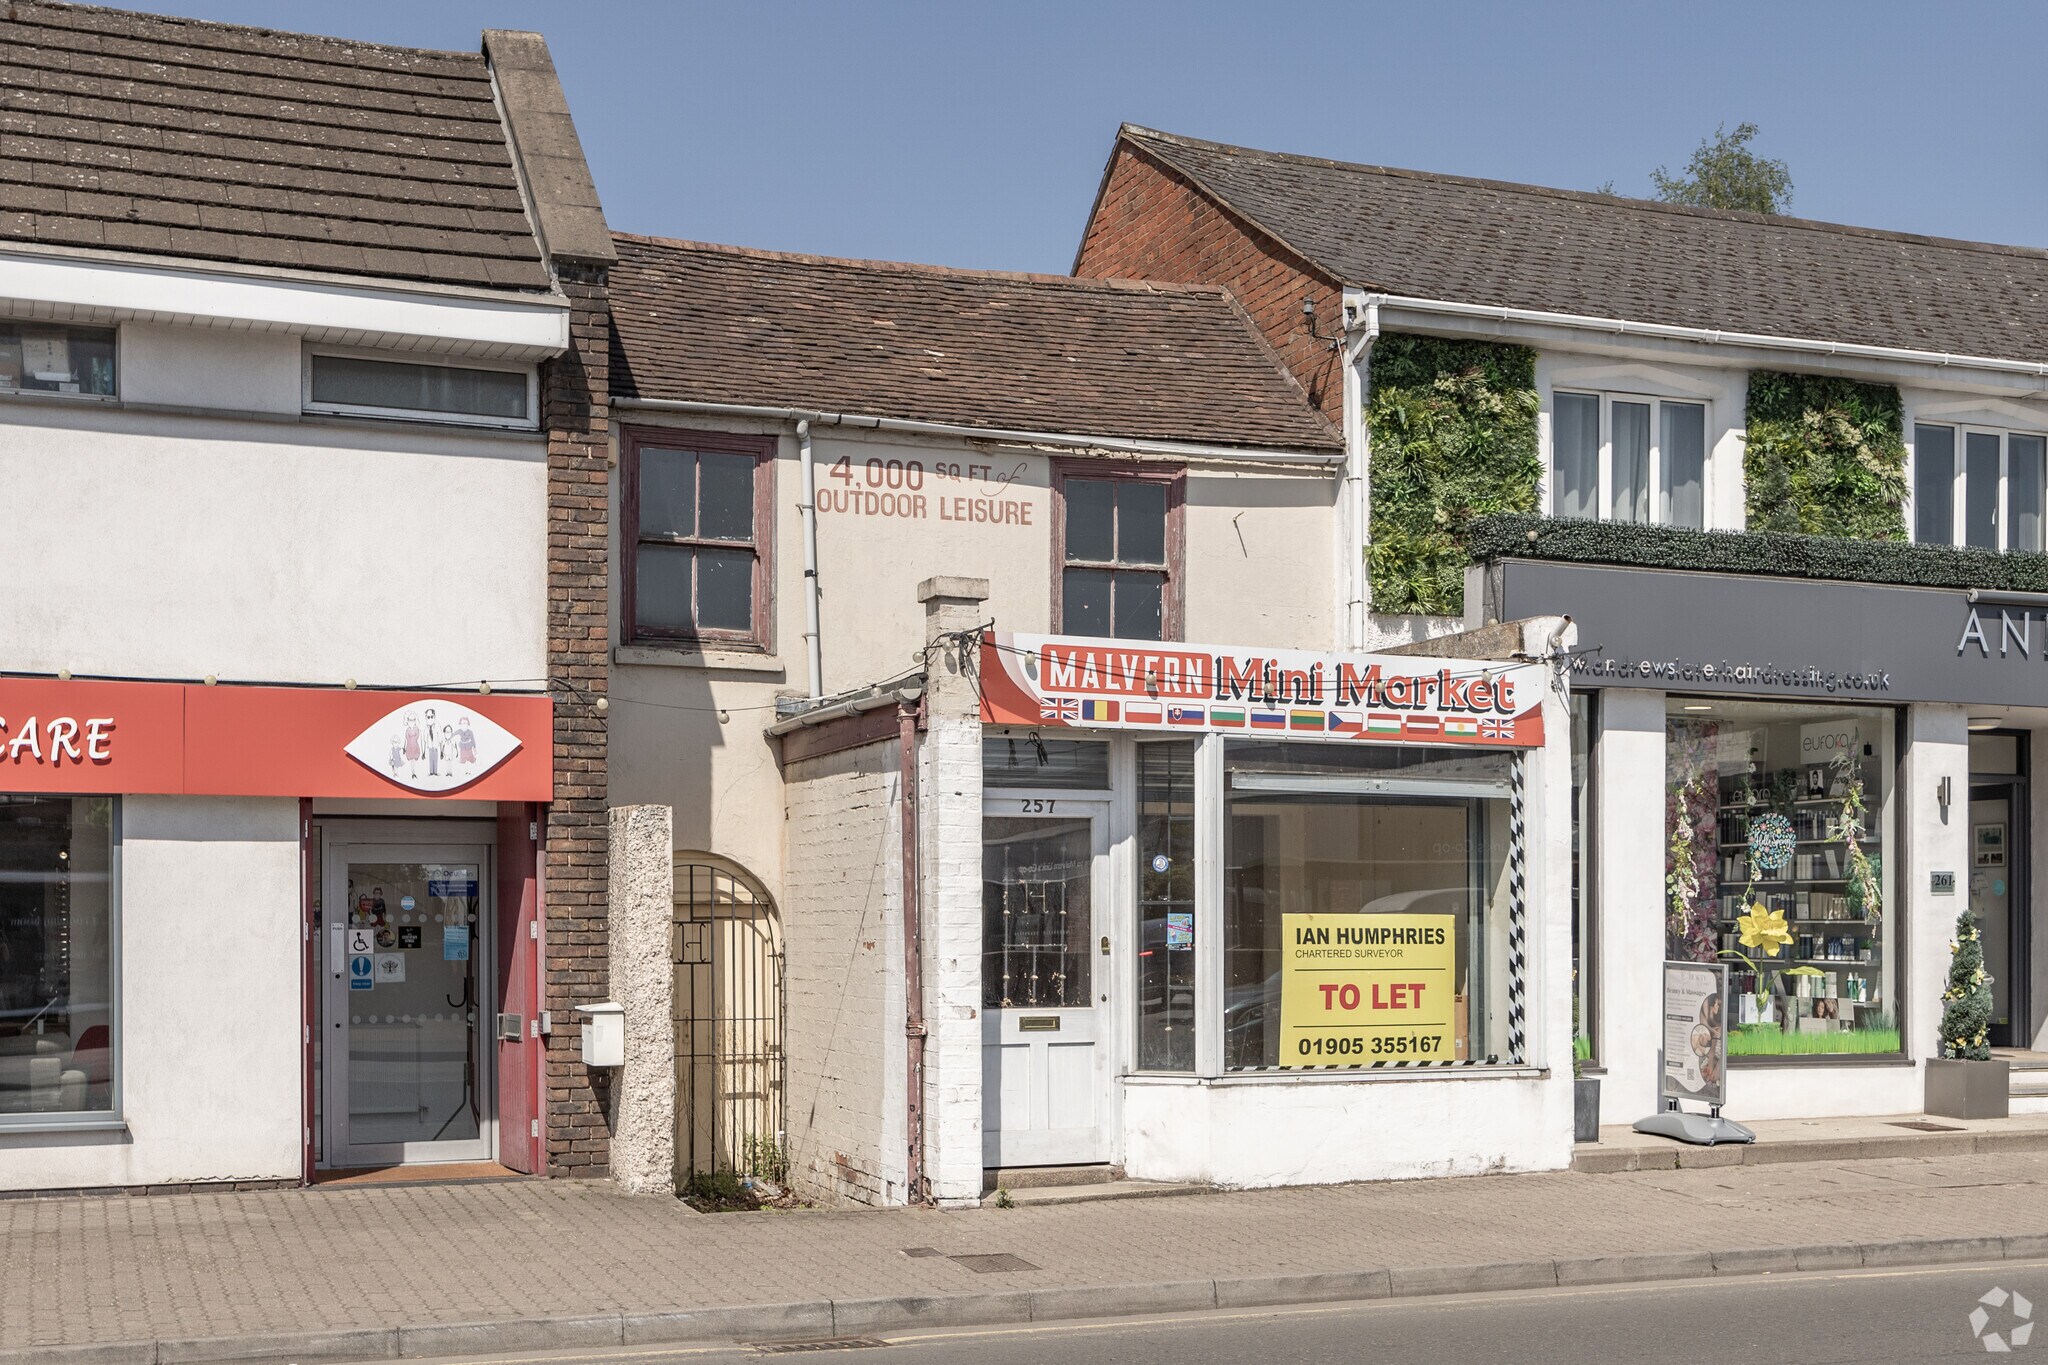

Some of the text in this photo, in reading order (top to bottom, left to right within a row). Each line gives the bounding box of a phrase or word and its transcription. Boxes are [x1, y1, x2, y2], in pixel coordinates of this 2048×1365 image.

[829, 456, 924, 491] 4,000
[936, 462, 961, 483] SQ
[969, 464, 992, 483] FT
[816, 488, 1033, 526] OUTDOOR LEISURE
[1958, 607, 2048, 656] AN
[1049, 649, 1517, 714] MALVERN Mini Market
[0, 716, 115, 762] ARE
[1021, 799, 1056, 814] 257
[1934, 874, 1953, 886] 261
[1296, 928, 1445, 945] IAN HUMPHRIES
[1295, 949, 1404, 959] CHARTERED SURVEYOR
[1319, 983, 1426, 1010] TO LET
[1298, 1036, 1442, 1055] 01905 355167
